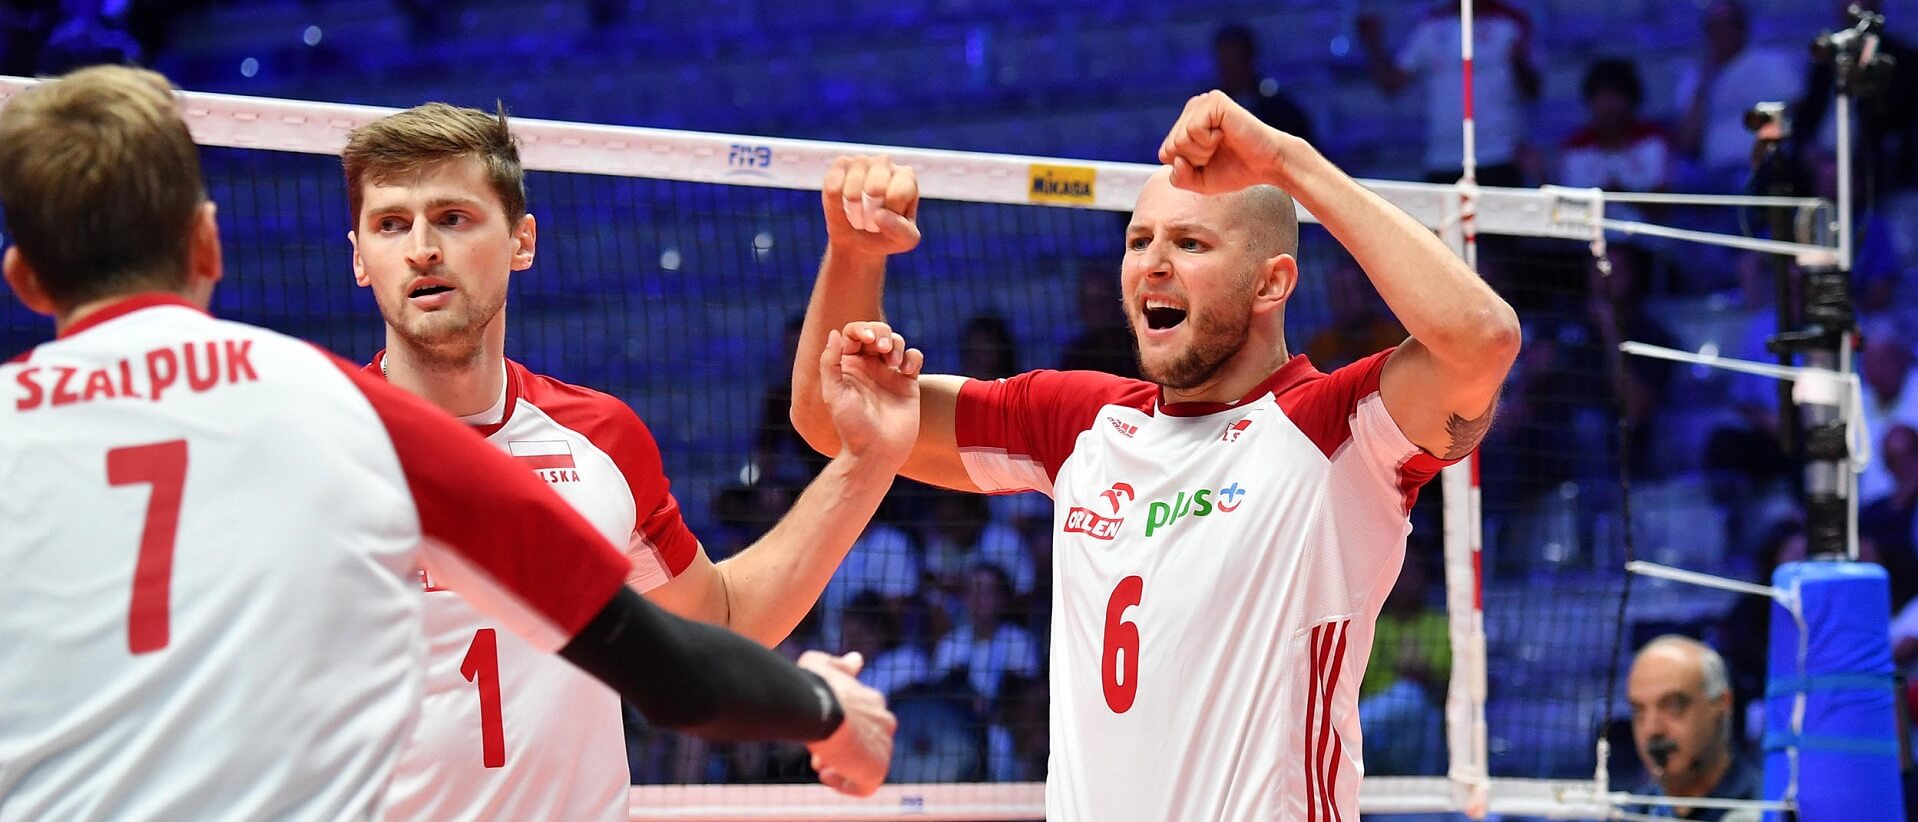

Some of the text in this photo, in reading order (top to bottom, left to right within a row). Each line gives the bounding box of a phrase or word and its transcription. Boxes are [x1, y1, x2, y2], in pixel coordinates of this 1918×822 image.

[16, 340, 259, 412] SZALPUK
[540, 470, 580, 483] LSKA
[1068, 510, 1120, 538] ORLEN
[106, 439, 188, 655] 7
[1101, 575, 1143, 714] 6
[460, 628, 505, 768] 1
